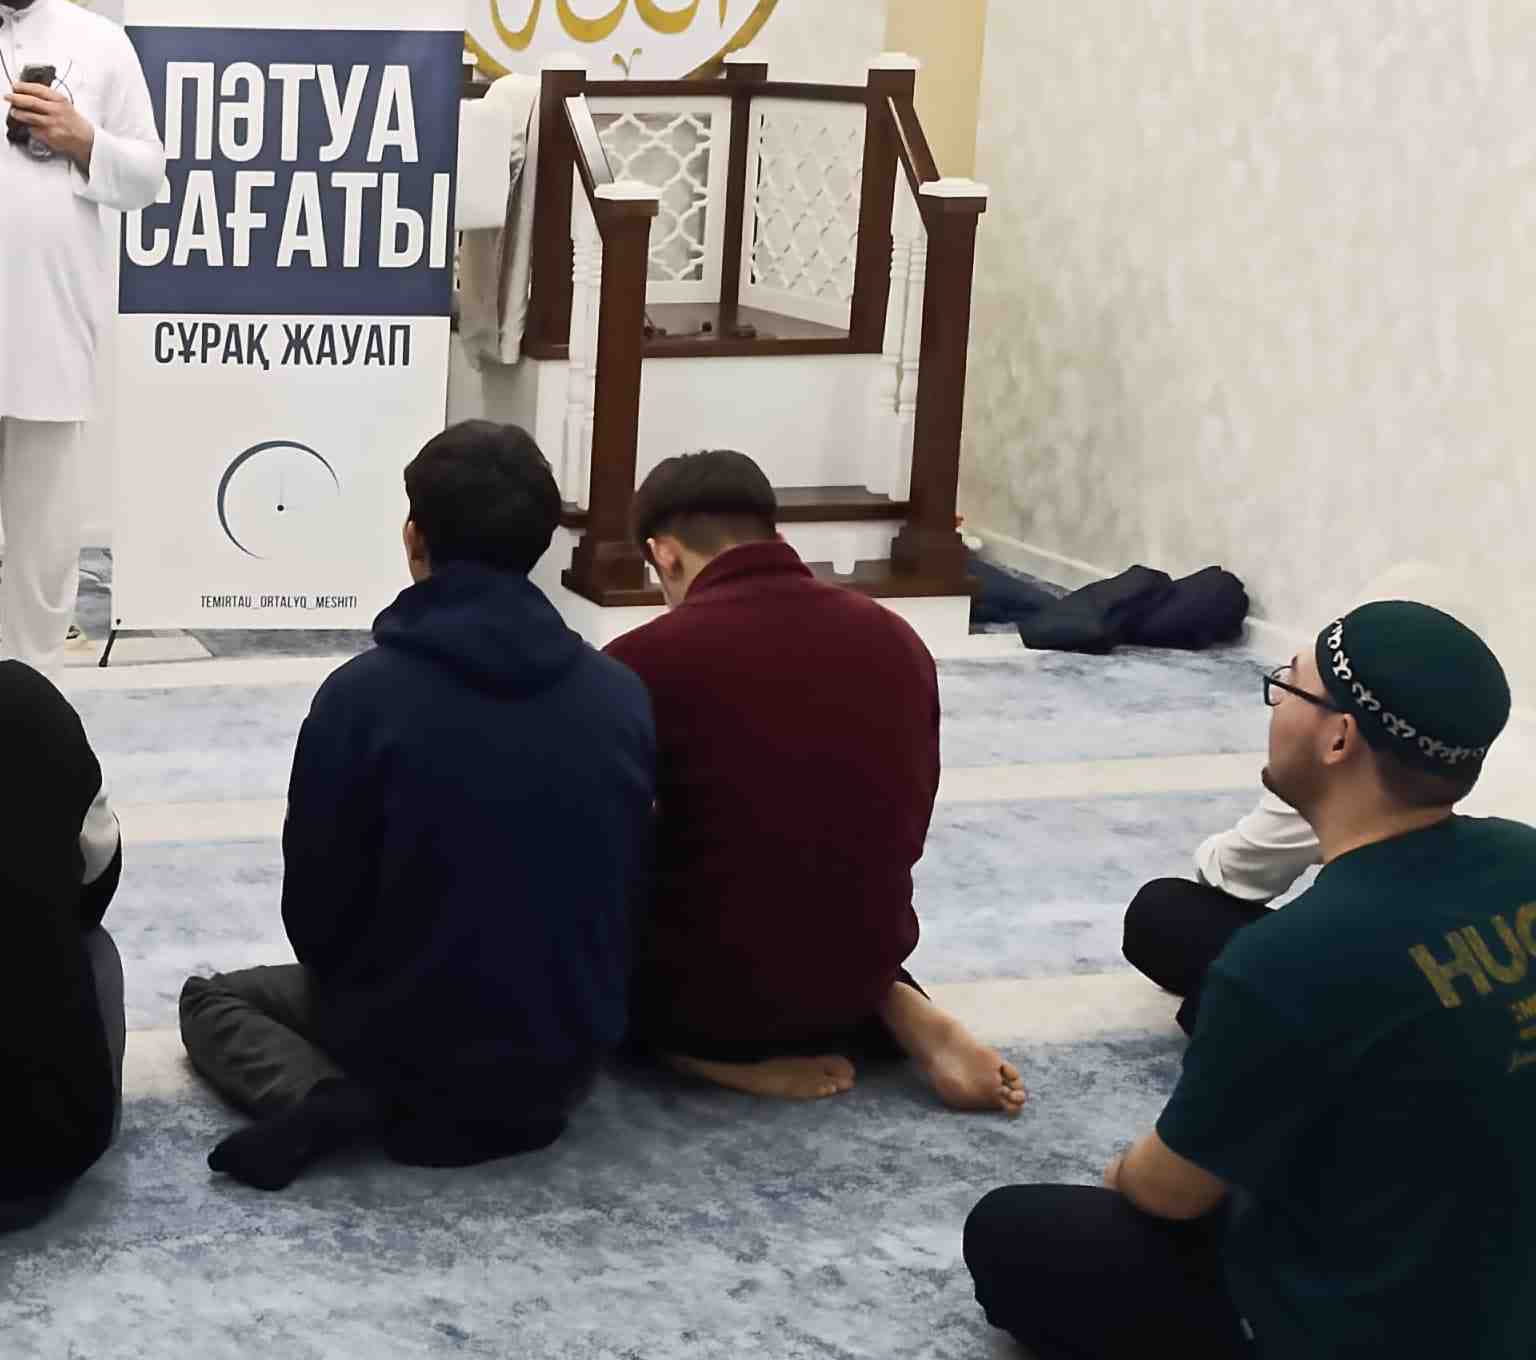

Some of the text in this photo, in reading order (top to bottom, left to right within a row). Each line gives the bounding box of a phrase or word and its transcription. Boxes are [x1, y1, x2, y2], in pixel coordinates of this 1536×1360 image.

[164, 61, 419, 163] ПӘТУА
[125, 170, 450, 269] САҒАТЫ
[154, 321, 411, 370] СҰРАҚ ЖАУАП
